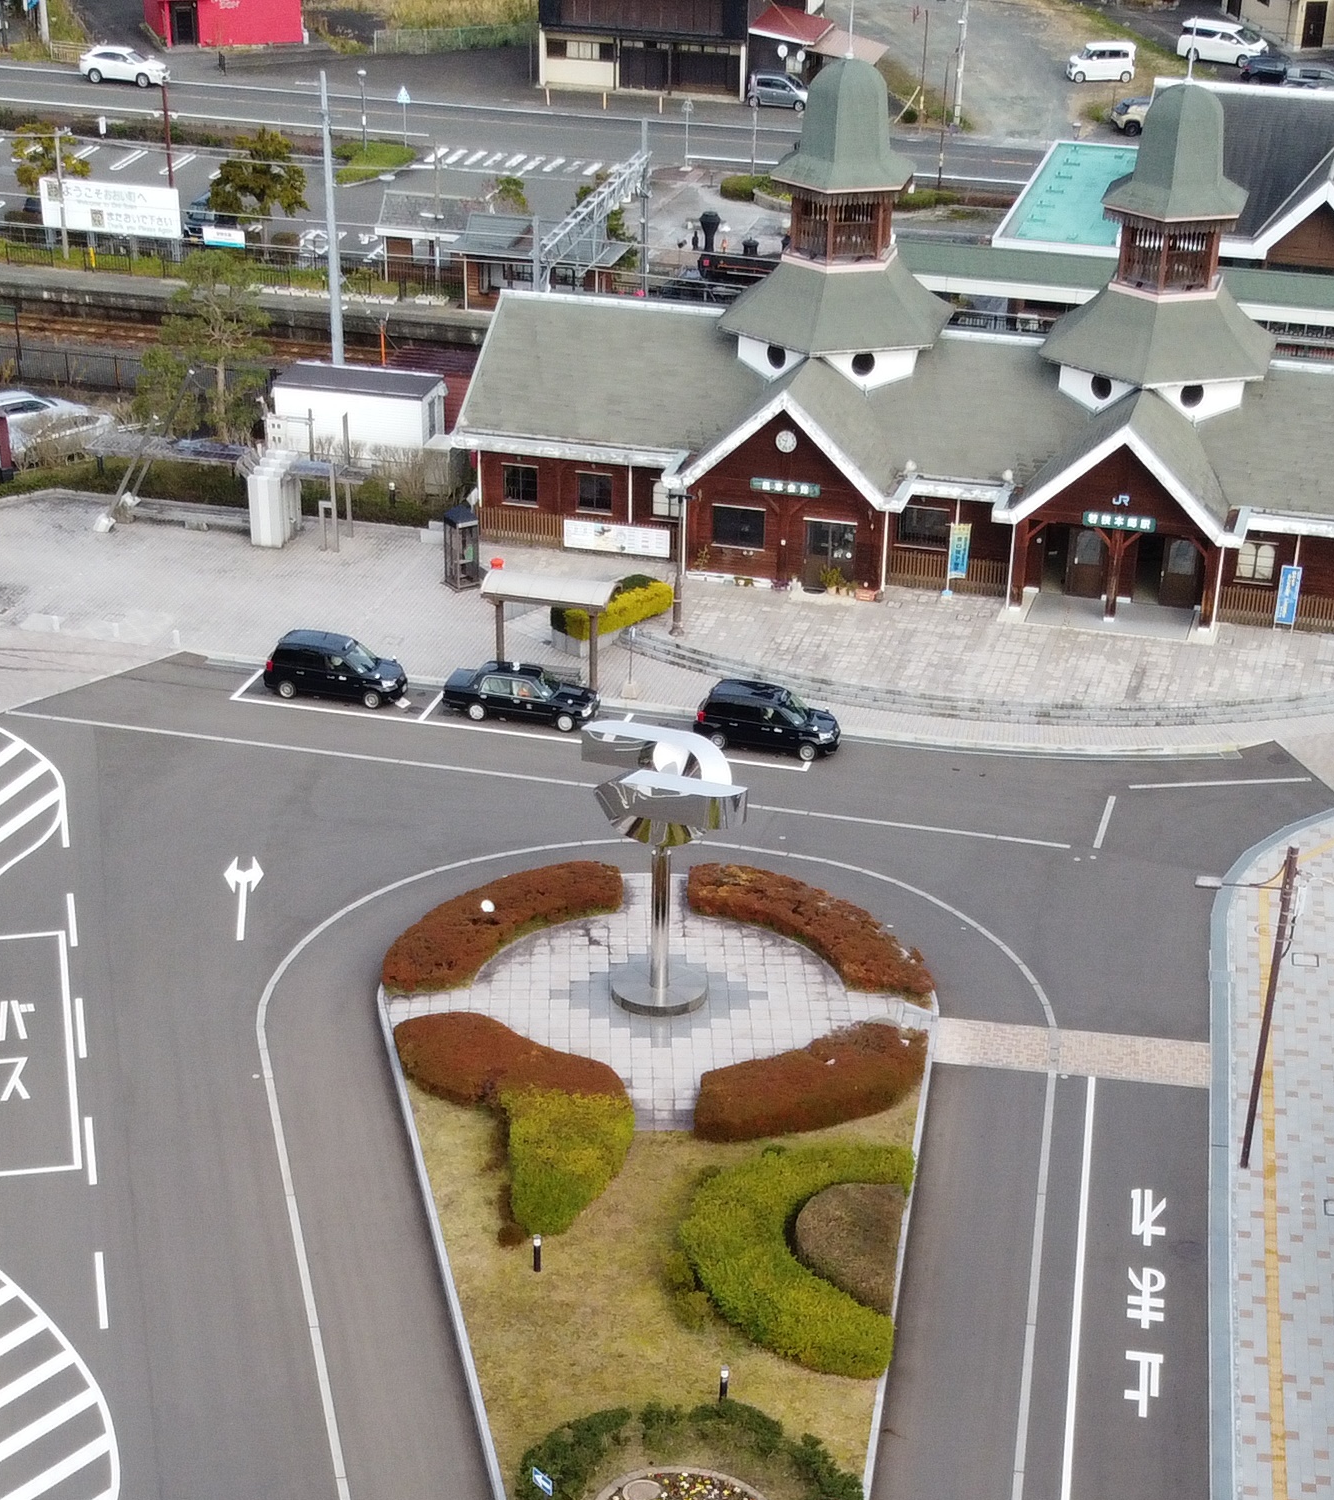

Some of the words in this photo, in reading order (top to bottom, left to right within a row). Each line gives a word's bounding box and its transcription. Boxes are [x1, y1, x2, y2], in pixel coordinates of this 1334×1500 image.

[1112, 494, 1130, 507] JR
[1124, 1188, 1166, 1417] 止まれ
